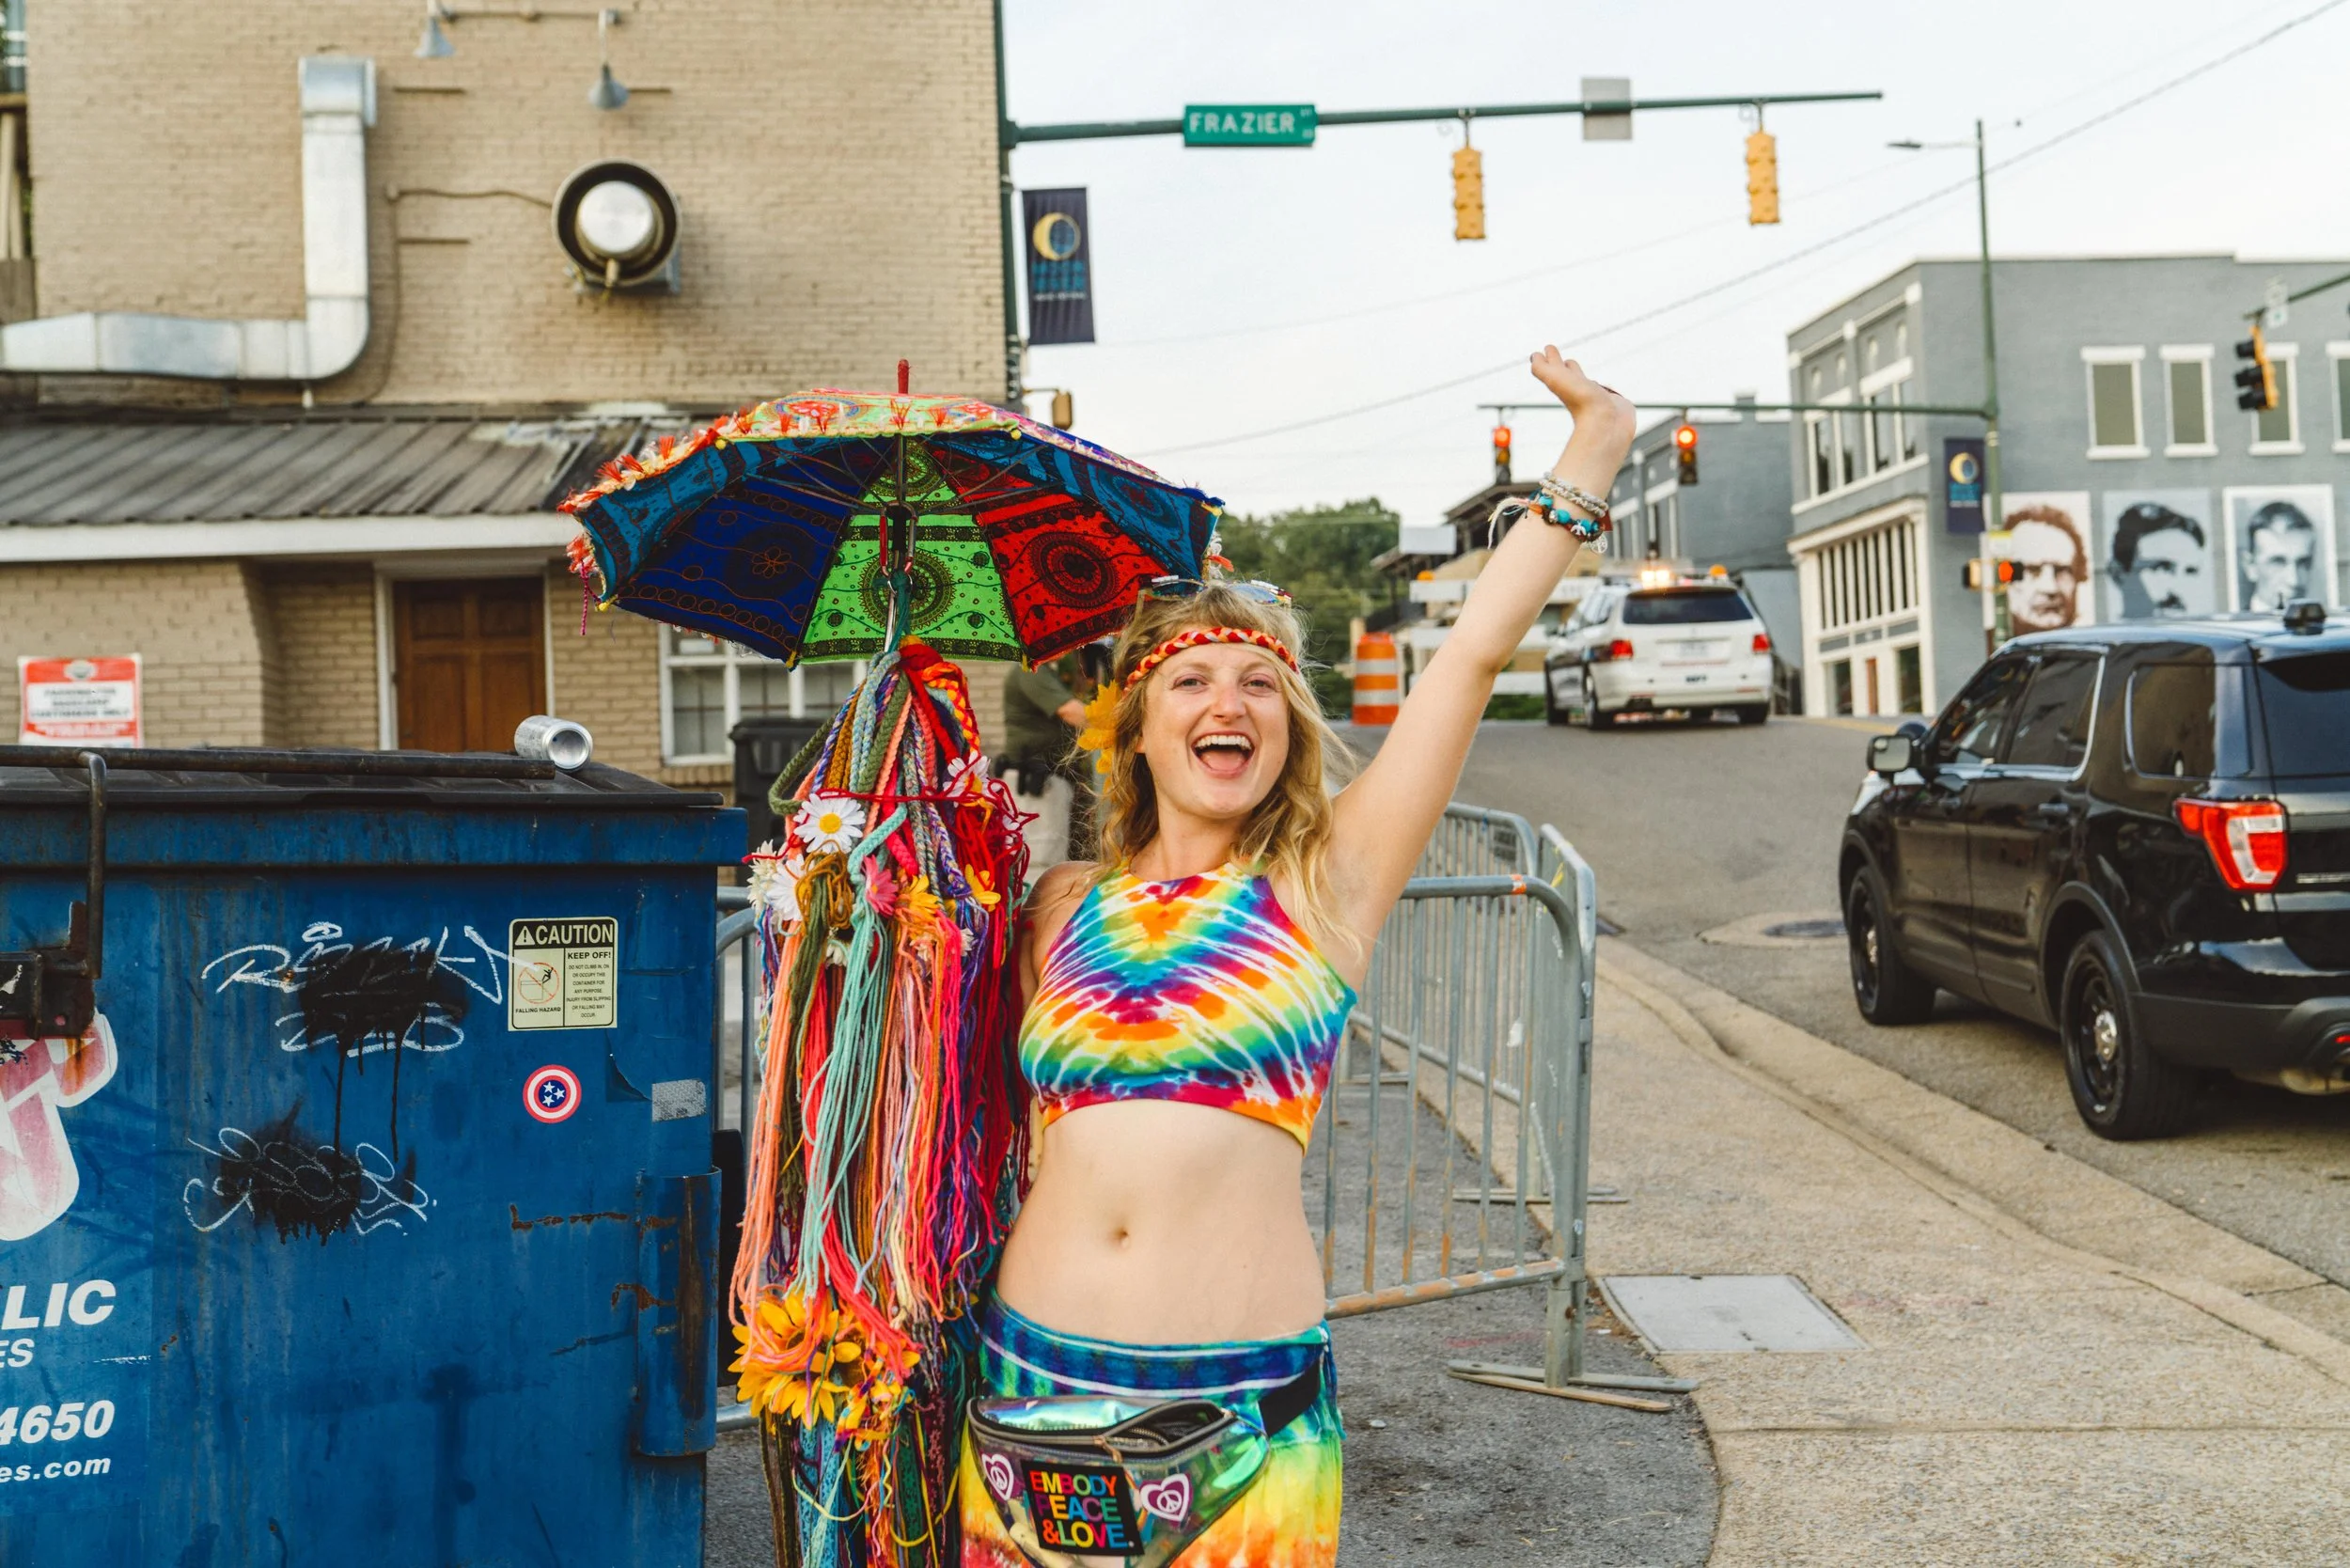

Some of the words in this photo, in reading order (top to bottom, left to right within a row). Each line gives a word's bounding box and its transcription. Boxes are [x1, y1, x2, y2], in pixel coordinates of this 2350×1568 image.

[1188, 111, 1295, 133] FRAZIER
[536, 924, 614, 945] CAUTION
[2, 1279, 117, 1330] LIC
[0, 1458, 111, 1482] es.com
[1029, 1470, 1117, 1497] EMBODY
[1035, 1494, 1121, 1522] PEACE
